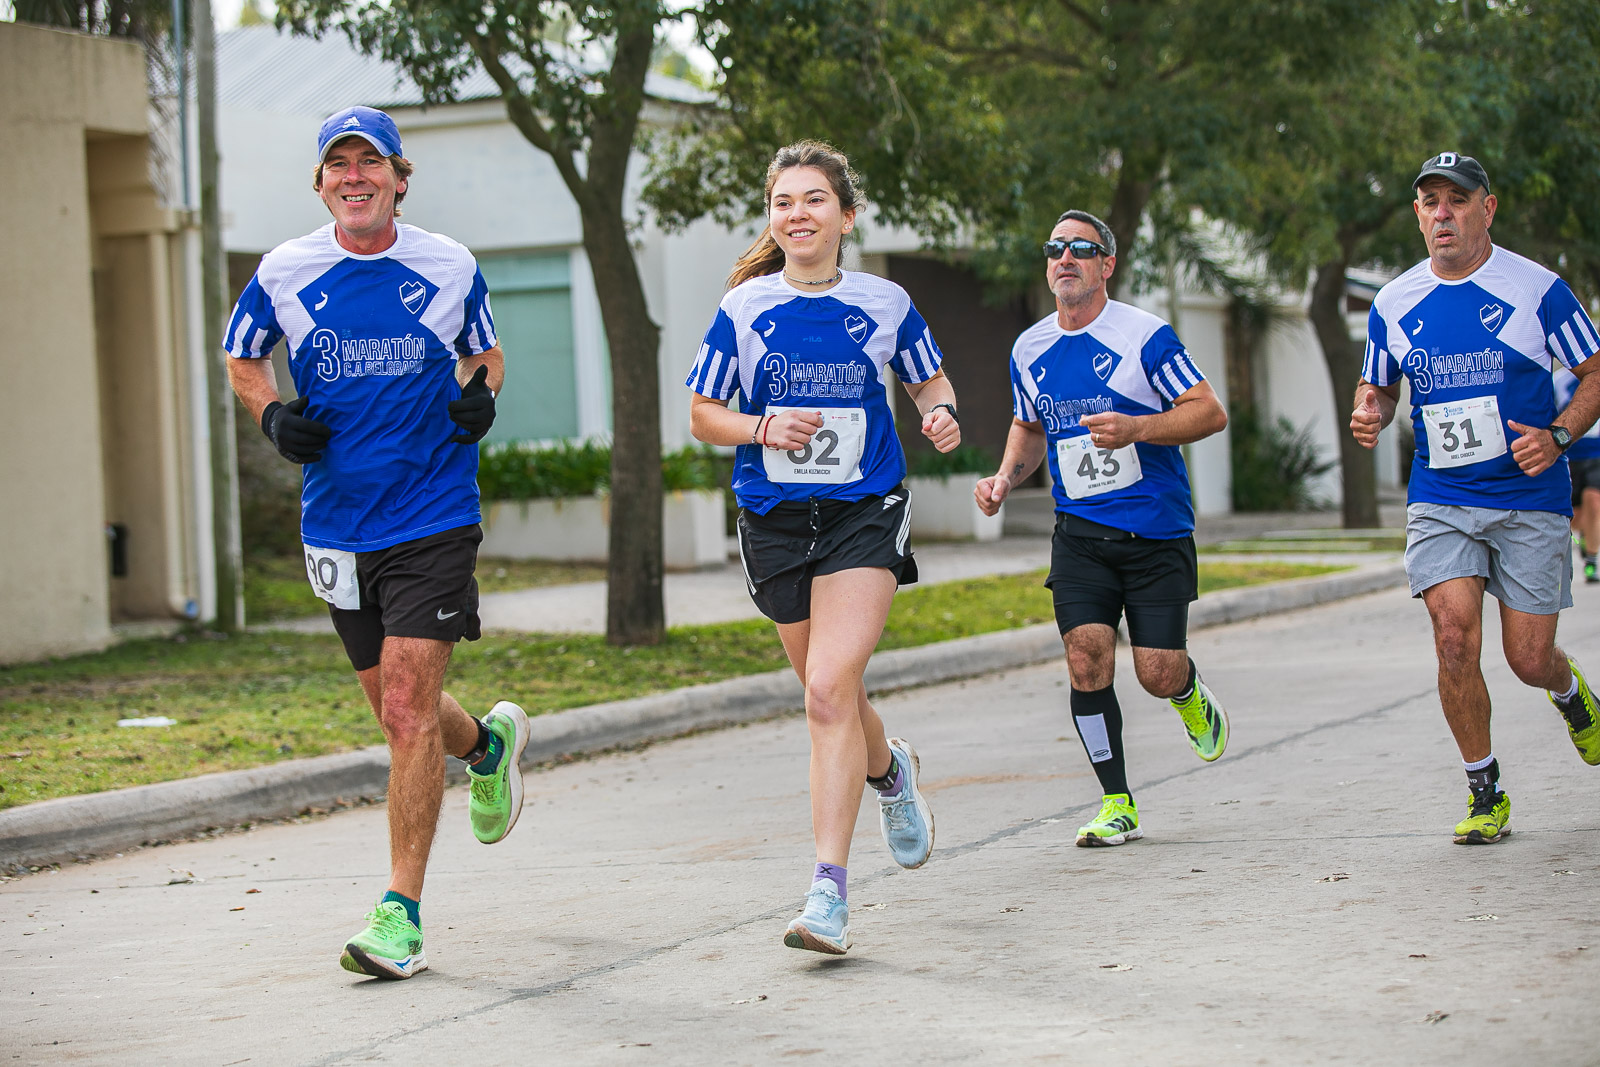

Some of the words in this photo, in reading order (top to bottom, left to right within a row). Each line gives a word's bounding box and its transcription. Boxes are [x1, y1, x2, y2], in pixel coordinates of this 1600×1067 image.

[1437, 152, 1457, 167] D
[313, 329, 340, 382] 3
[342, 334, 425, 361] MARATÓN
[1408, 348, 1433, 394] 3
[1431, 348, 1504, 375] MARATÓN
[764, 352, 788, 401] 3
[790, 360, 866, 384] MARATÓN
[1038, 394, 1060, 434] 3
[1438, 418, 1483, 452] 31
[1077, 449, 1120, 481] 43
[307, 553, 338, 591] 90
